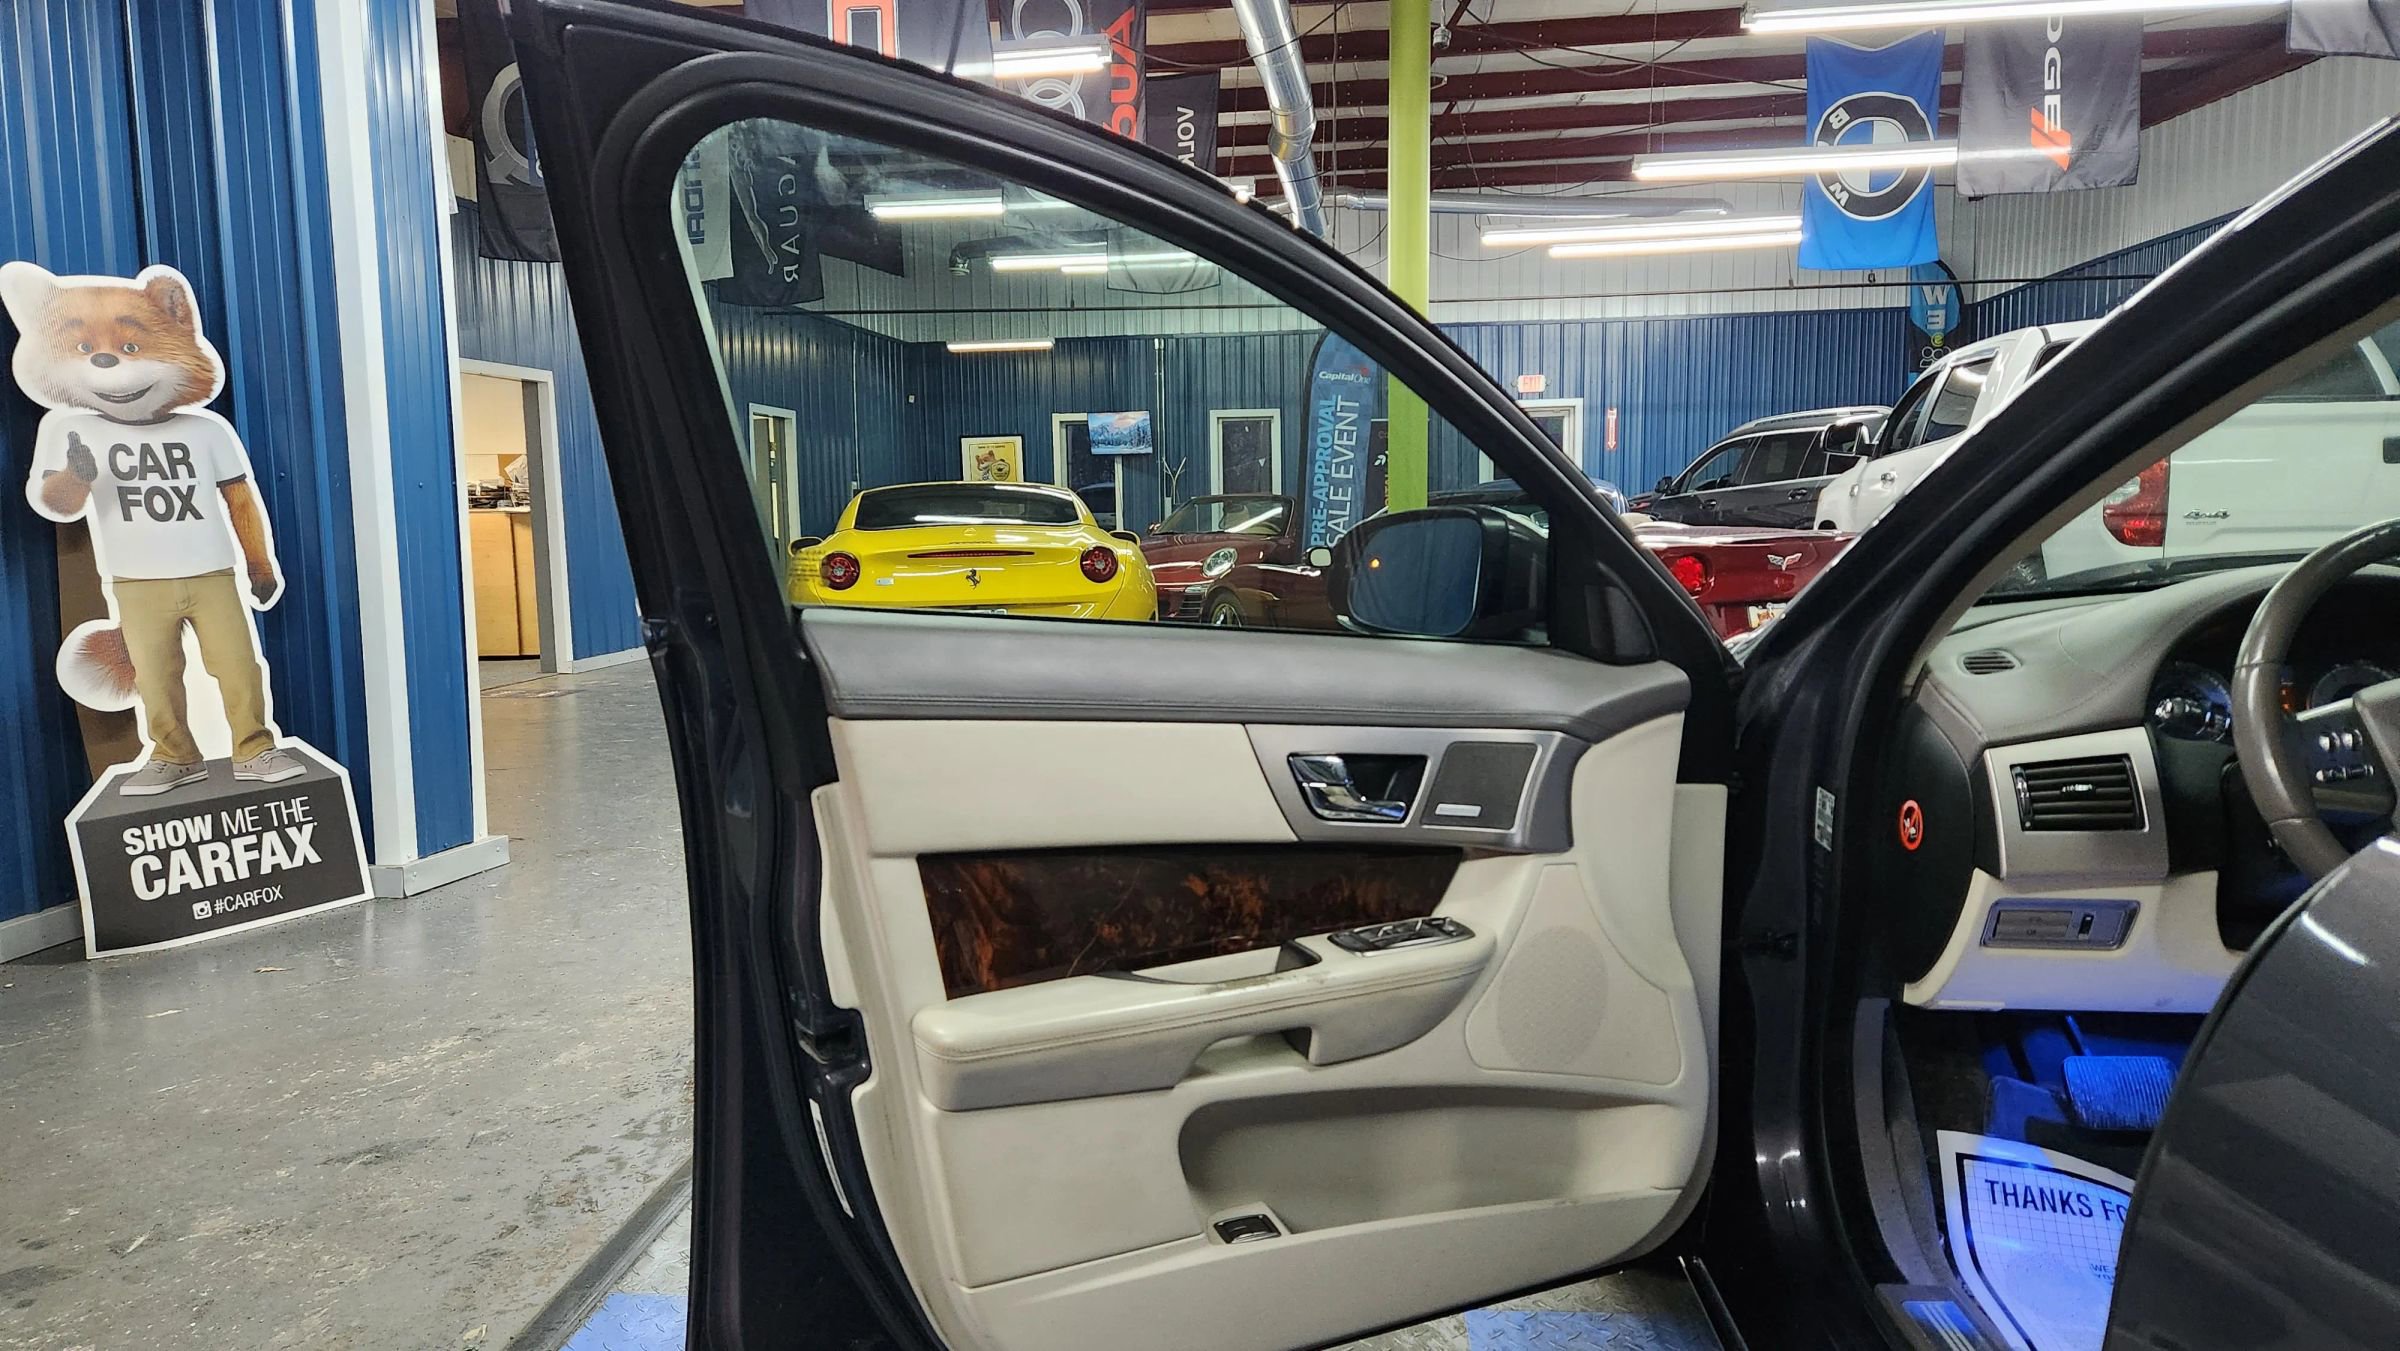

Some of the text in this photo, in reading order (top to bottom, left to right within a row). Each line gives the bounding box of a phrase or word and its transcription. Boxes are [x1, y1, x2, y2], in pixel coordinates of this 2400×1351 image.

[108, 442, 197, 481] CAR
[1310, 395, 1337, 546] PRE-APPROVAL
[1326, 395, 1360, 548] SALE EVENT
[116, 484, 206, 522] FOX
[122, 796, 314, 856] SHOW ME THE
[130, 822, 323, 901] CARFAX
[213, 884, 284, 914] #CARFOX
[1984, 1179, 2093, 1218] THANKS
